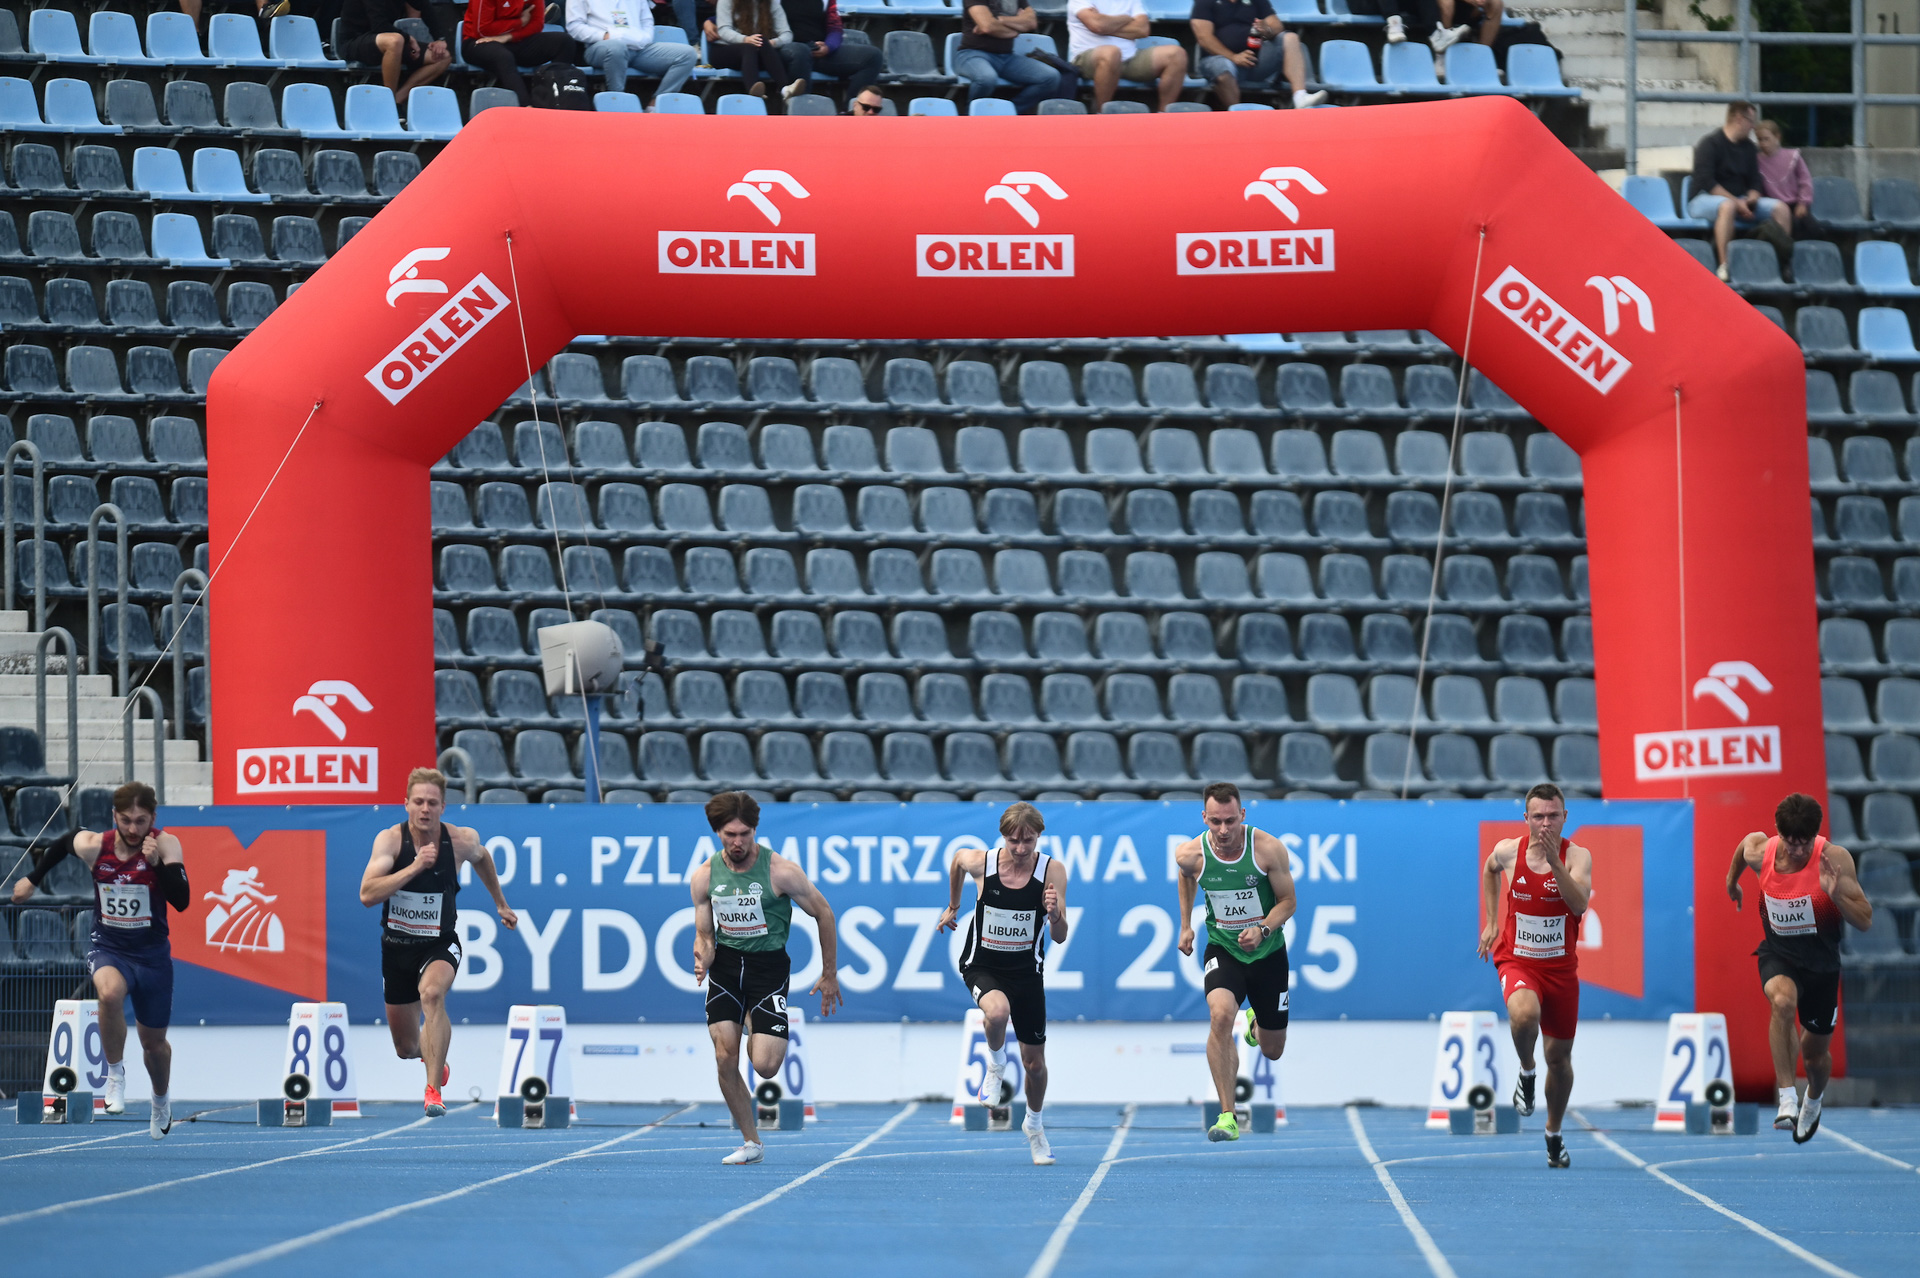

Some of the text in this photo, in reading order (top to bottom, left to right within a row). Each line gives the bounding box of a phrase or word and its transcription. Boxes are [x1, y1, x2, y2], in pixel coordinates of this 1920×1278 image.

[666, 237, 805, 269] ORLEN
[925, 241, 1063, 271] ORLEN
[1185, 236, 1323, 269] ORLEN
[381, 284, 499, 390] ORLEN
[1499, 281, 1618, 382] ORLEN
[1643, 734, 1772, 770] ORLEN
[243, 754, 368, 786] ORLEN
[590, 836, 717, 885] PZLA
[757, 834, 1147, 884] ISTRZOWA
[1166, 833, 1357, 882] PSKI
[106, 898, 141, 916] 559
[422, 896, 435, 904] 15
[737, 897, 757, 906] 220
[1224, 905, 1248, 917] ŻAK
[1234, 891, 1254, 901] 122
[1788, 898, 1807, 908] 329
[391, 905, 439, 920] ŁUKOMSKI
[719, 912, 758, 923] DURKA
[1012, 913, 1031, 922] 458
[1542, 918, 1562, 928] 127
[1771, 912, 1806, 923] FUJAK
[988, 925, 1028, 937] LIBURA
[1517, 929, 1563, 944] LEPIONKA
[1115, 903, 1358, 992] 25
[778, 996, 787, 1011] 6
[1282, 994, 1288, 1008] 4
[53, 1021, 73, 1067] 9
[84, 1022, 109, 1089] 9
[290, 1024, 311, 1077] 8
[323, 1024, 348, 1091] 8
[509, 1027, 530, 1094] 7
[540, 1027, 563, 1095] 7
[784, 1031, 804, 1096] 6
[965, 1032, 988, 1097] 5
[1253, 1049, 1275, 1099] 4
[1442, 1034, 1464, 1100] 3
[1477, 1034, 1498, 1092] 3
[1668, 1036, 1696, 1101] 2
